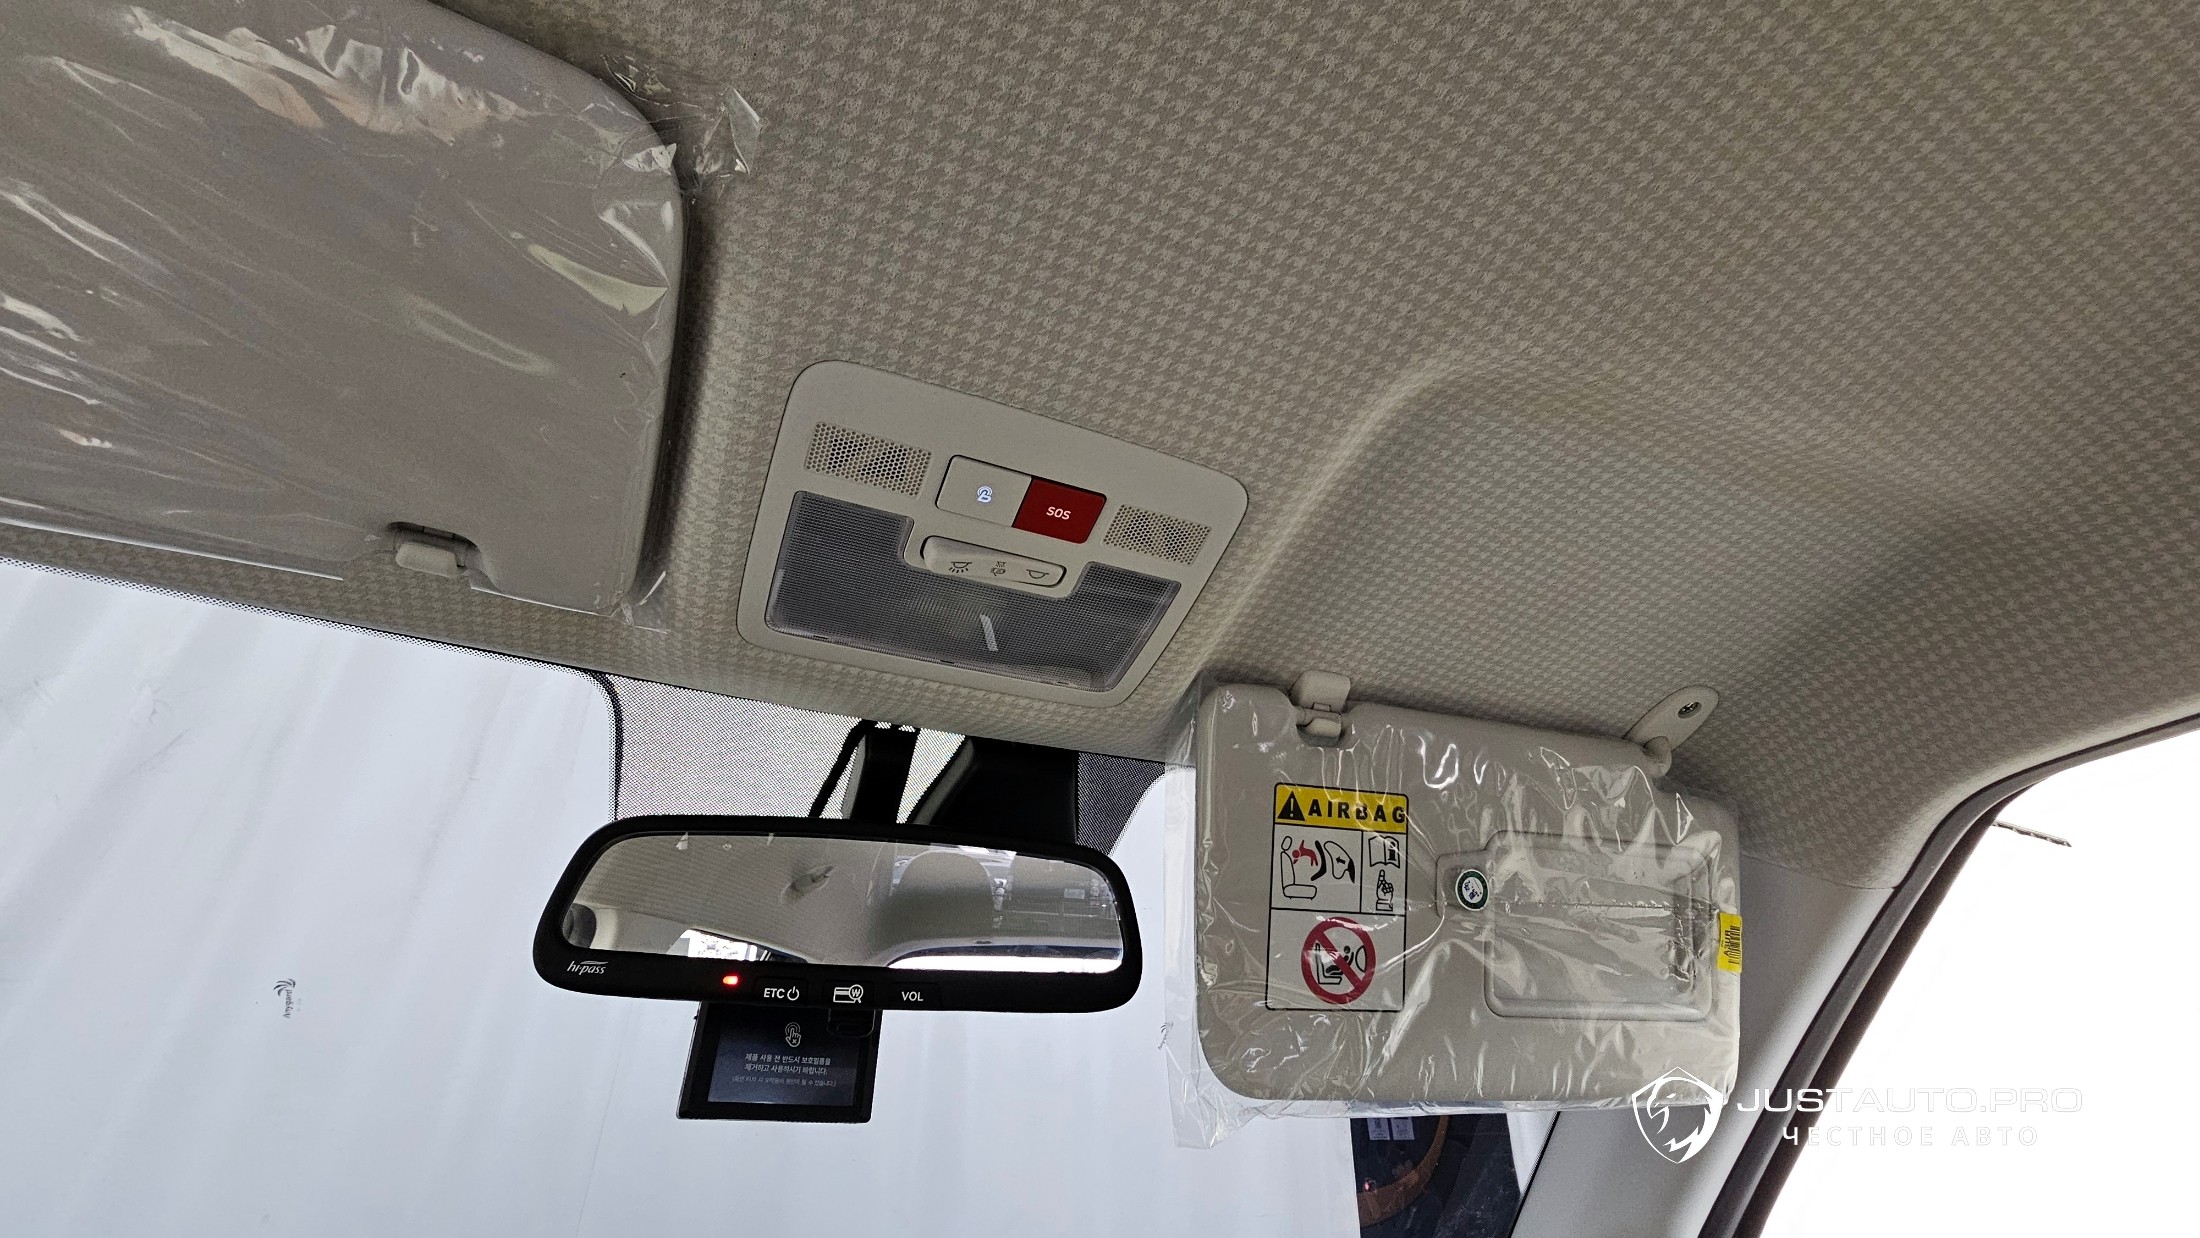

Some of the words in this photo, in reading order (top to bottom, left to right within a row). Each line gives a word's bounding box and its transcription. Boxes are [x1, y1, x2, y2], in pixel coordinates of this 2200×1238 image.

[1046, 506, 1071, 520] SOS
[1307, 798, 1406, 823] AIRBAG
[763, 987, 785, 999] ETC
[901, 991, 924, 1002] VOL
[745, 1053, 758, 1062] 제품
[760, 1054, 772, 1063] 사용
[773, 1054, 781, 1063] 전
[782, 1055, 800, 1064] 반드시
[801, 1056, 831, 1066] 보호필름을
[744, 1063, 770, 1072] 제거하고
[770, 1064, 801, 1074] 사용하시기
